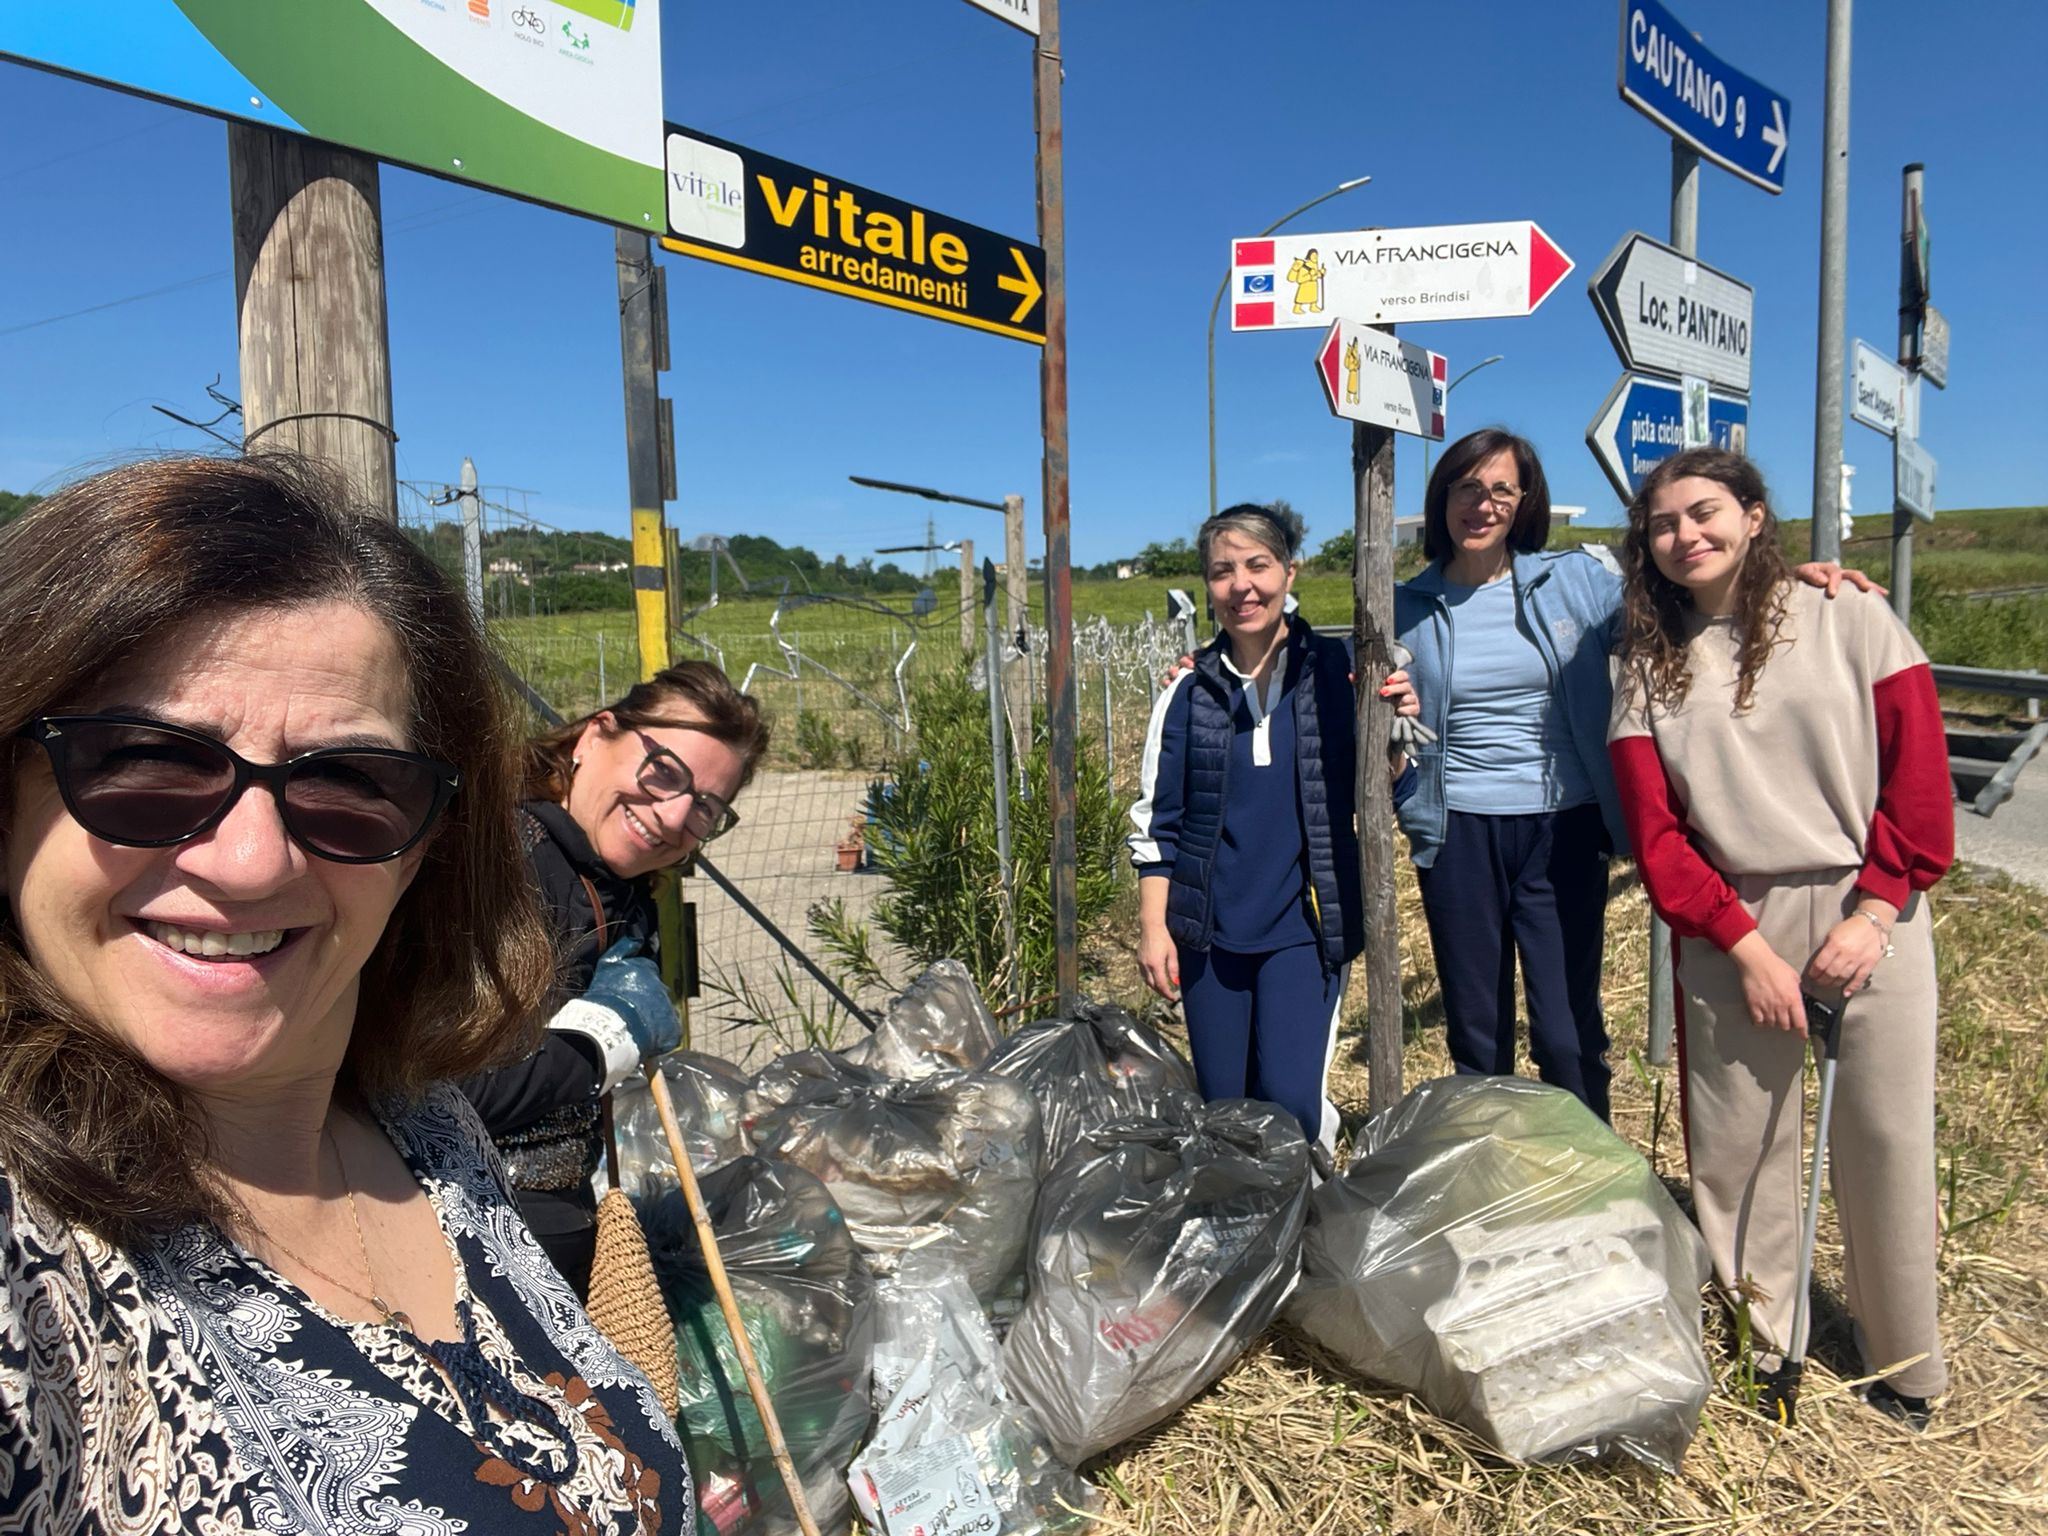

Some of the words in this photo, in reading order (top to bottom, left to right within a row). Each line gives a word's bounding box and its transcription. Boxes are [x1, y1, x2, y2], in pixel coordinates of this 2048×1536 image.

[1631, 9, 1727, 127] CAUTANO
[1735, 96, 1747, 138] 9
[671, 171, 742, 207] vitale
[757, 174, 970, 275] vitale
[1335, 249, 1371, 265] VIA
[1376, 240, 1518, 264] FRANCIGENA
[800, 246, 968, 309] arredamenti
[1380, 295, 1415, 306] verso
[1420, 291, 1470, 304] Brindisi
[1639, 281, 1673, 333] Loc.
[1678, 296, 1748, 356] PANTANO
[1364, 344, 1379, 365] VIA
[1380, 350, 1430, 382] FRANCIGENA
[1632, 411, 1656, 448] pista
